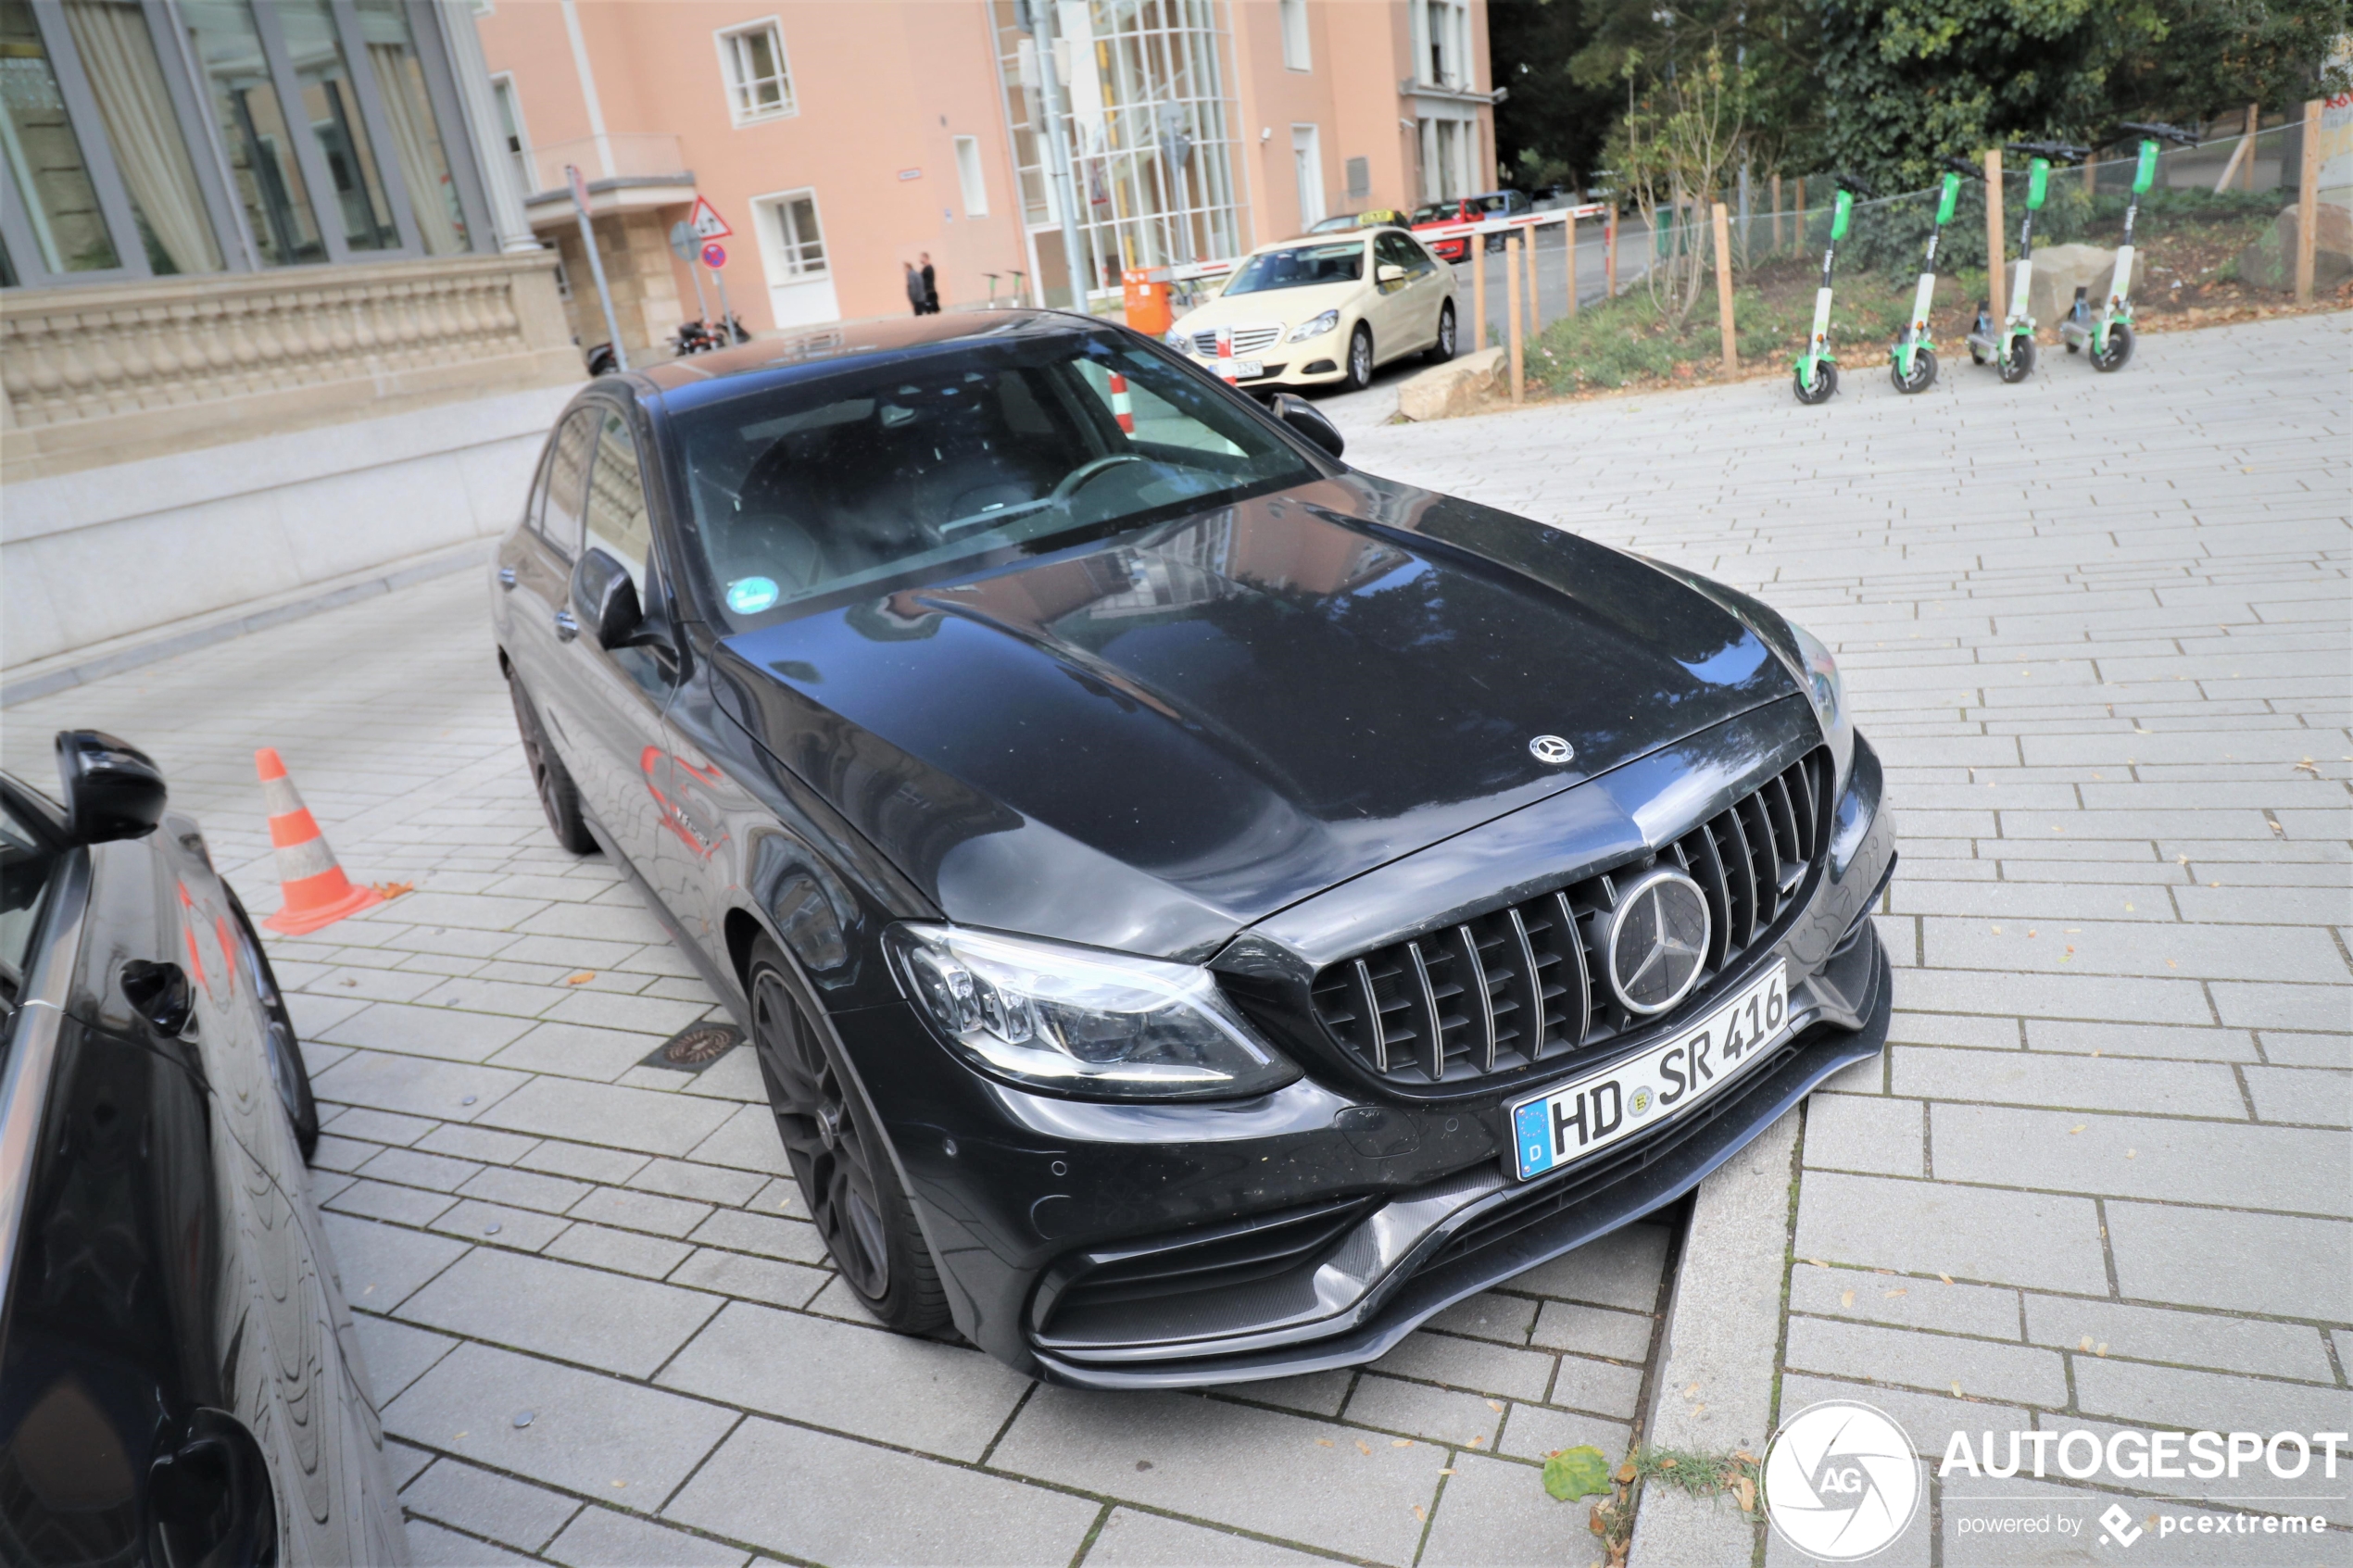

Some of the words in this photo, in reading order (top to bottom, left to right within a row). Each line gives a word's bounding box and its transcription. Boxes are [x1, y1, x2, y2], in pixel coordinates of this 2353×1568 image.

[747, 583, 758, 596] 4
[1552, 1080, 1622, 1156] HD
[1659, 1031, 1714, 1106] SR
[1723, 977, 1783, 1060] 416
[1529, 1145, 1541, 1161] D
